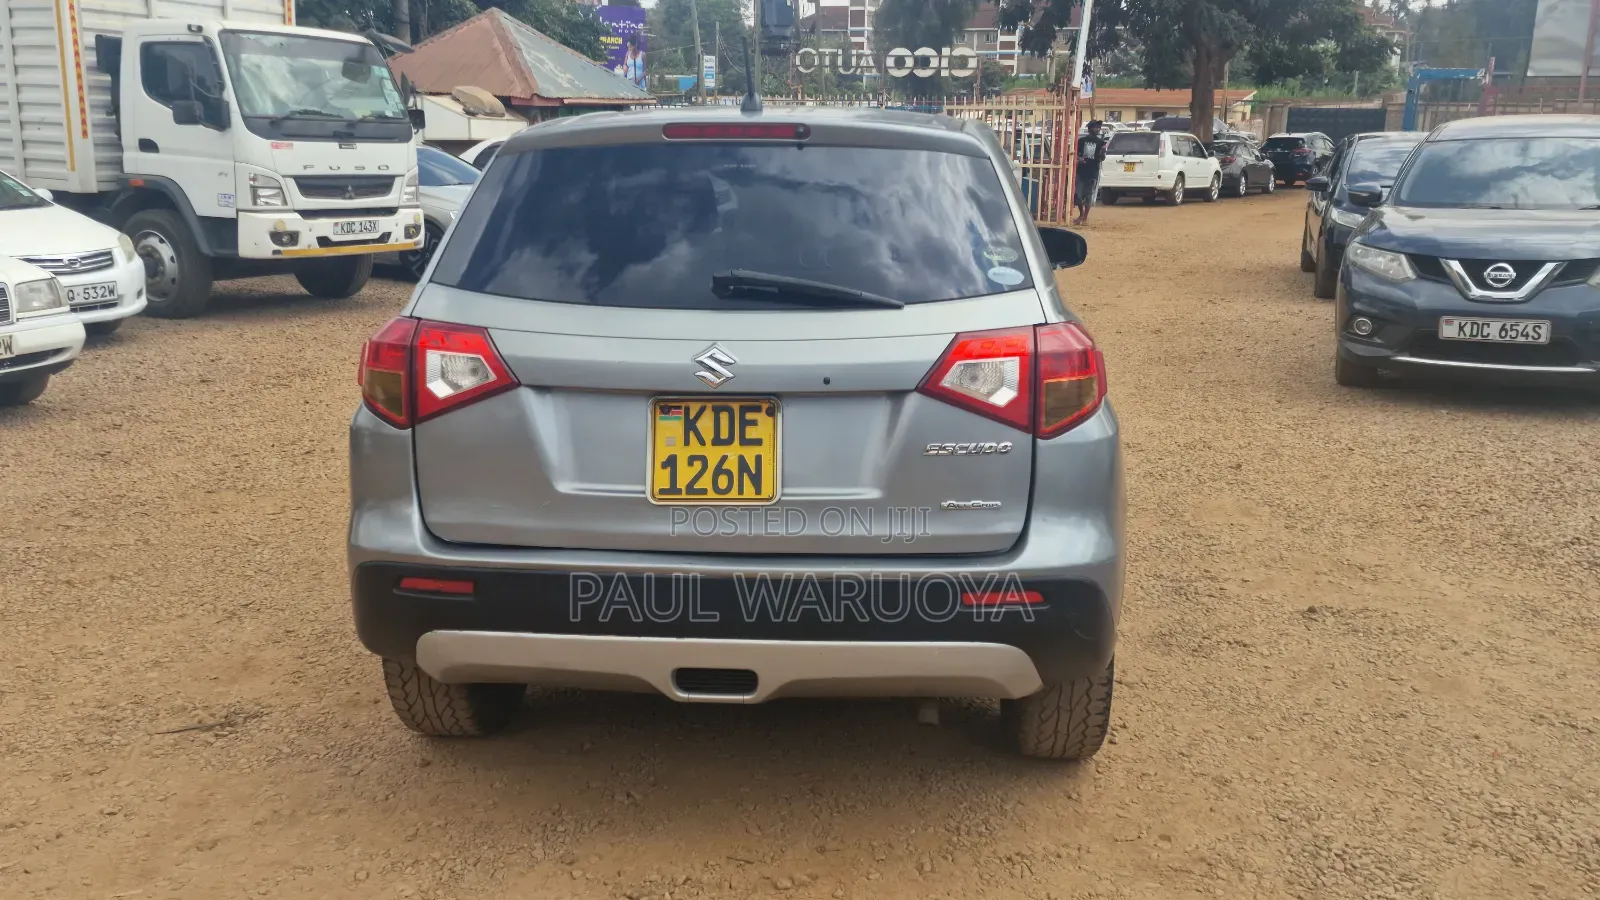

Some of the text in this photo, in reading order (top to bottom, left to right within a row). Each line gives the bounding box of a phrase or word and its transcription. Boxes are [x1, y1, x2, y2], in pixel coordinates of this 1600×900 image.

[340, 222, 378, 234] KDC 143X
[1457, 321, 1542, 341] KDC 654S
[683, 405, 763, 446] KDE
[923, 441, 1013, 456] ESCUDO
[658, 453, 762, 496] 126N
